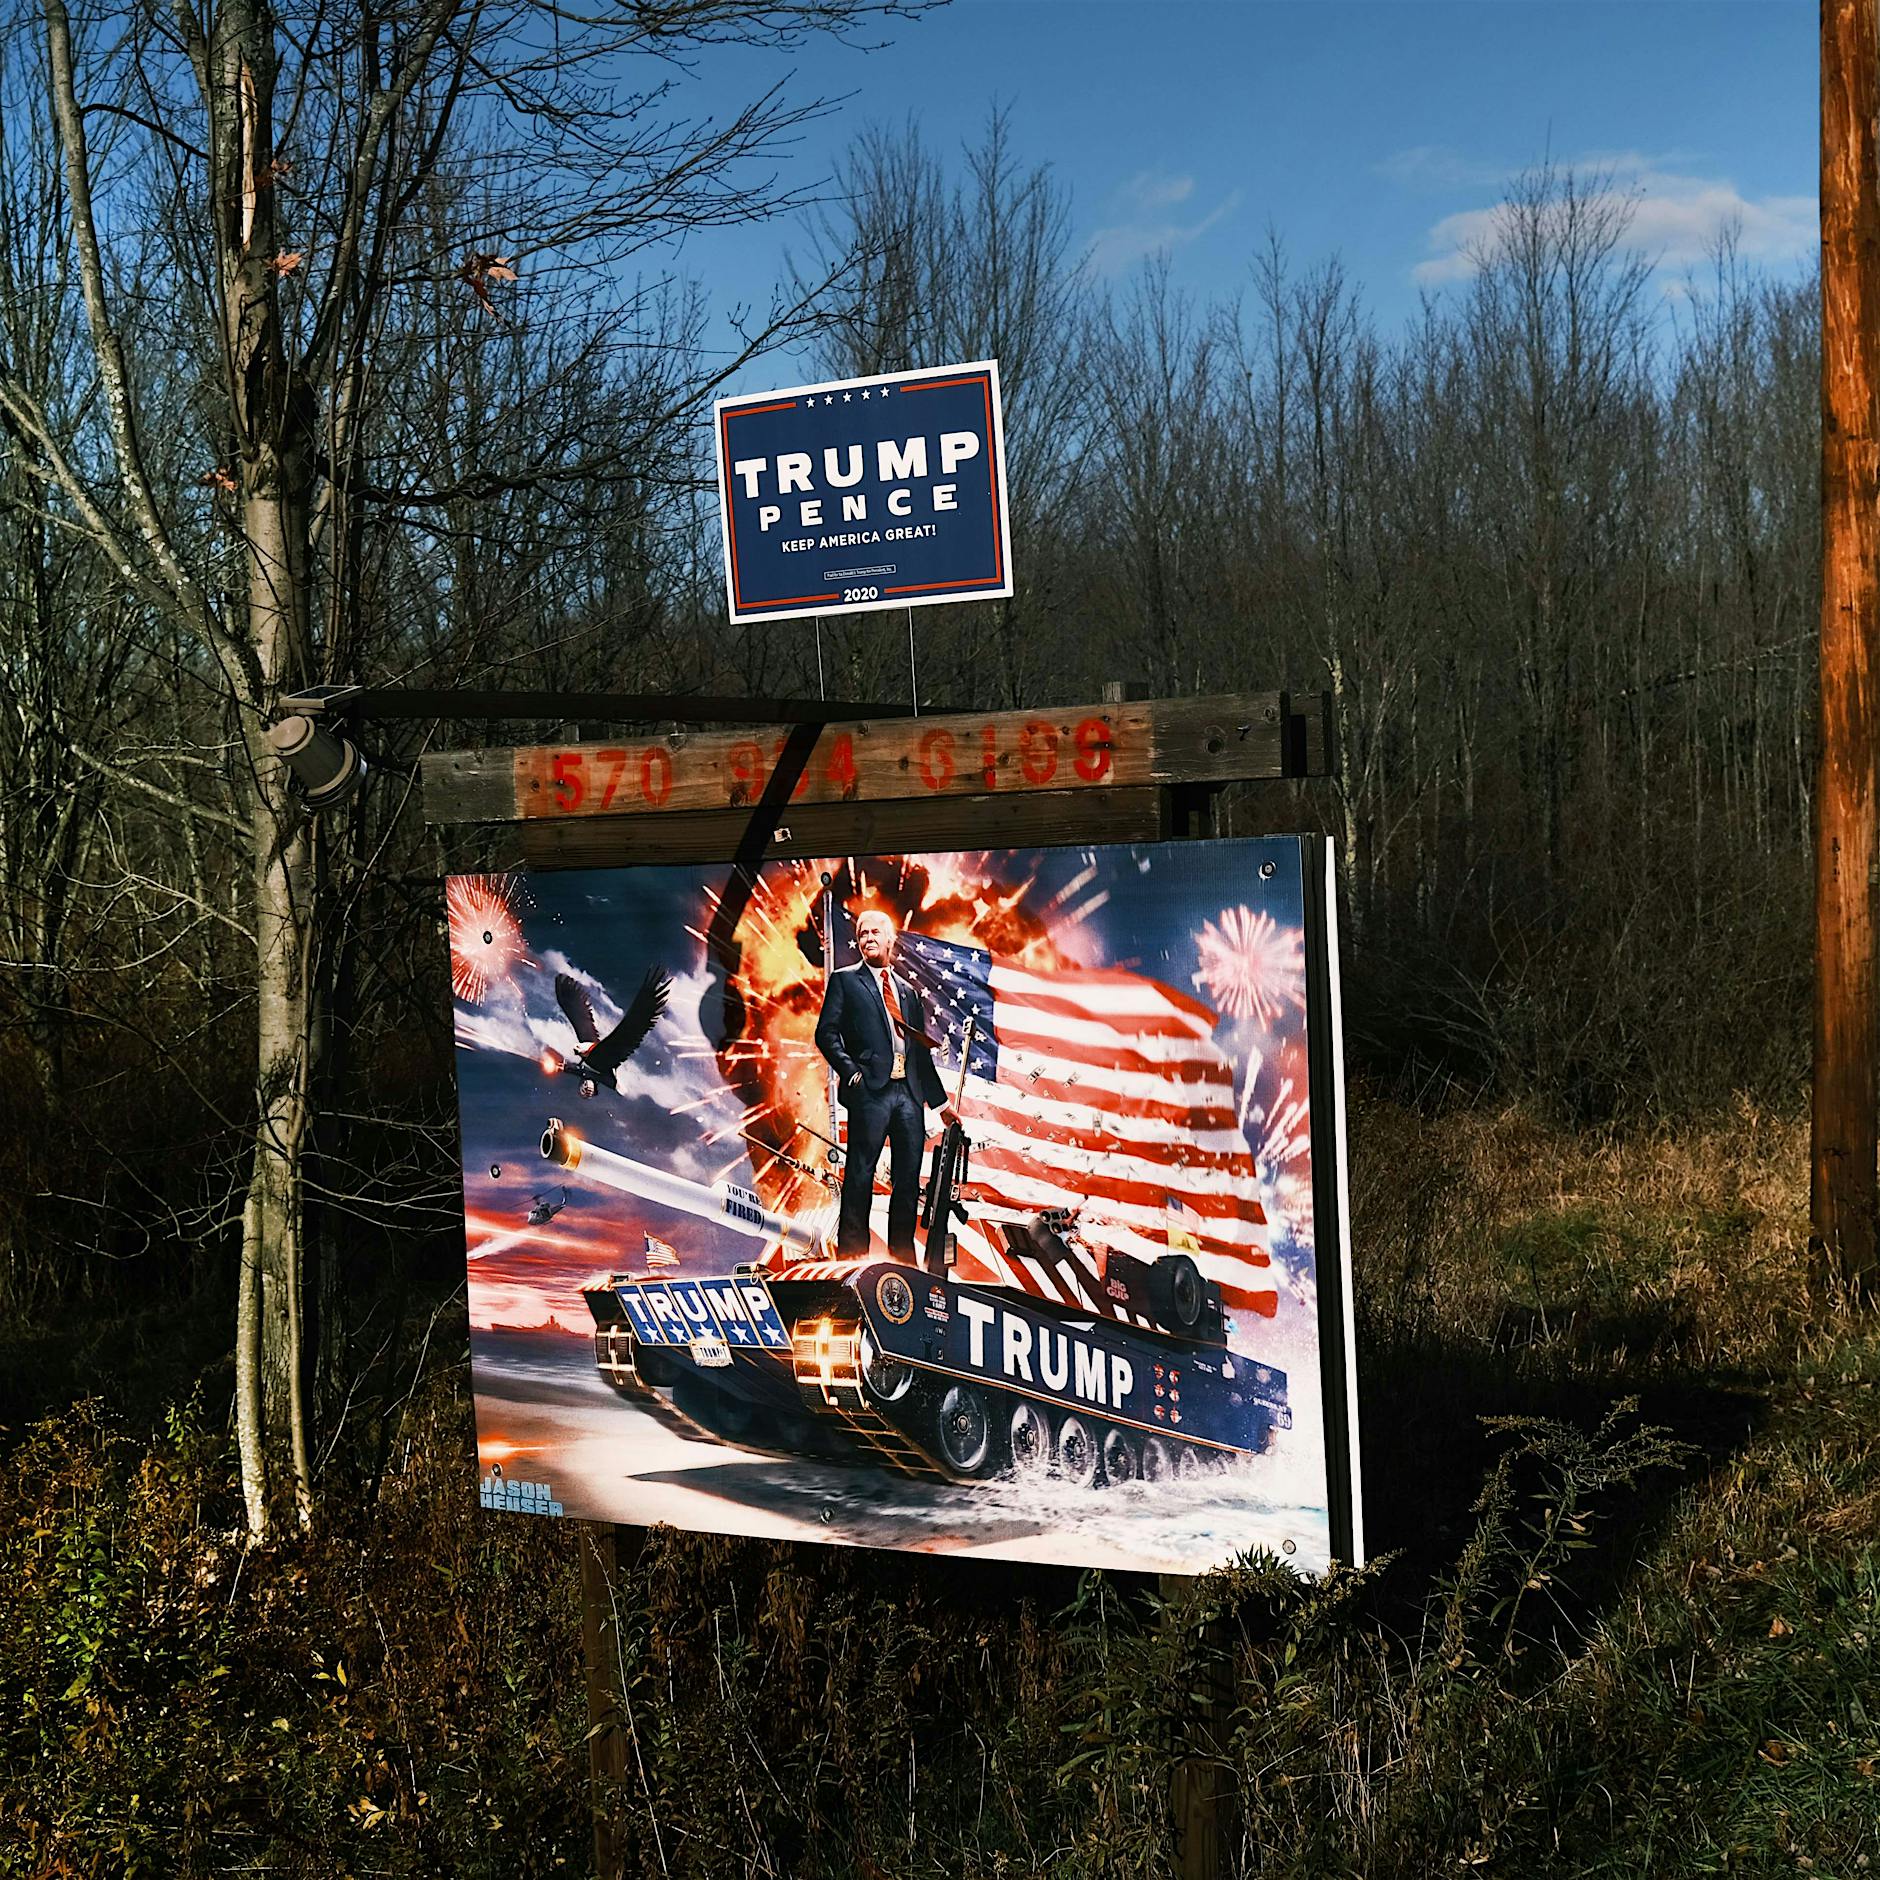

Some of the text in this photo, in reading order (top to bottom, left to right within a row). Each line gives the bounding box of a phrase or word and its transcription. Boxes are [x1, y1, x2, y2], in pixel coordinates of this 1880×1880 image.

[734, 431, 980, 499] TRUMP
[758, 484, 958, 531] PENCE
[781, 524, 937, 553] KEEP AMERICA GREAT!
[843, 586, 878, 602] 2020
[553, 746, 673, 812] 570
[726, 1198, 762, 1225] FIRED
[621, 1287, 771, 1323] TRUMP
[957, 1295, 1134, 1410] TRUMP
[480, 1477, 552, 1500] JASON
[480, 1493, 564, 1517] HEUSER
